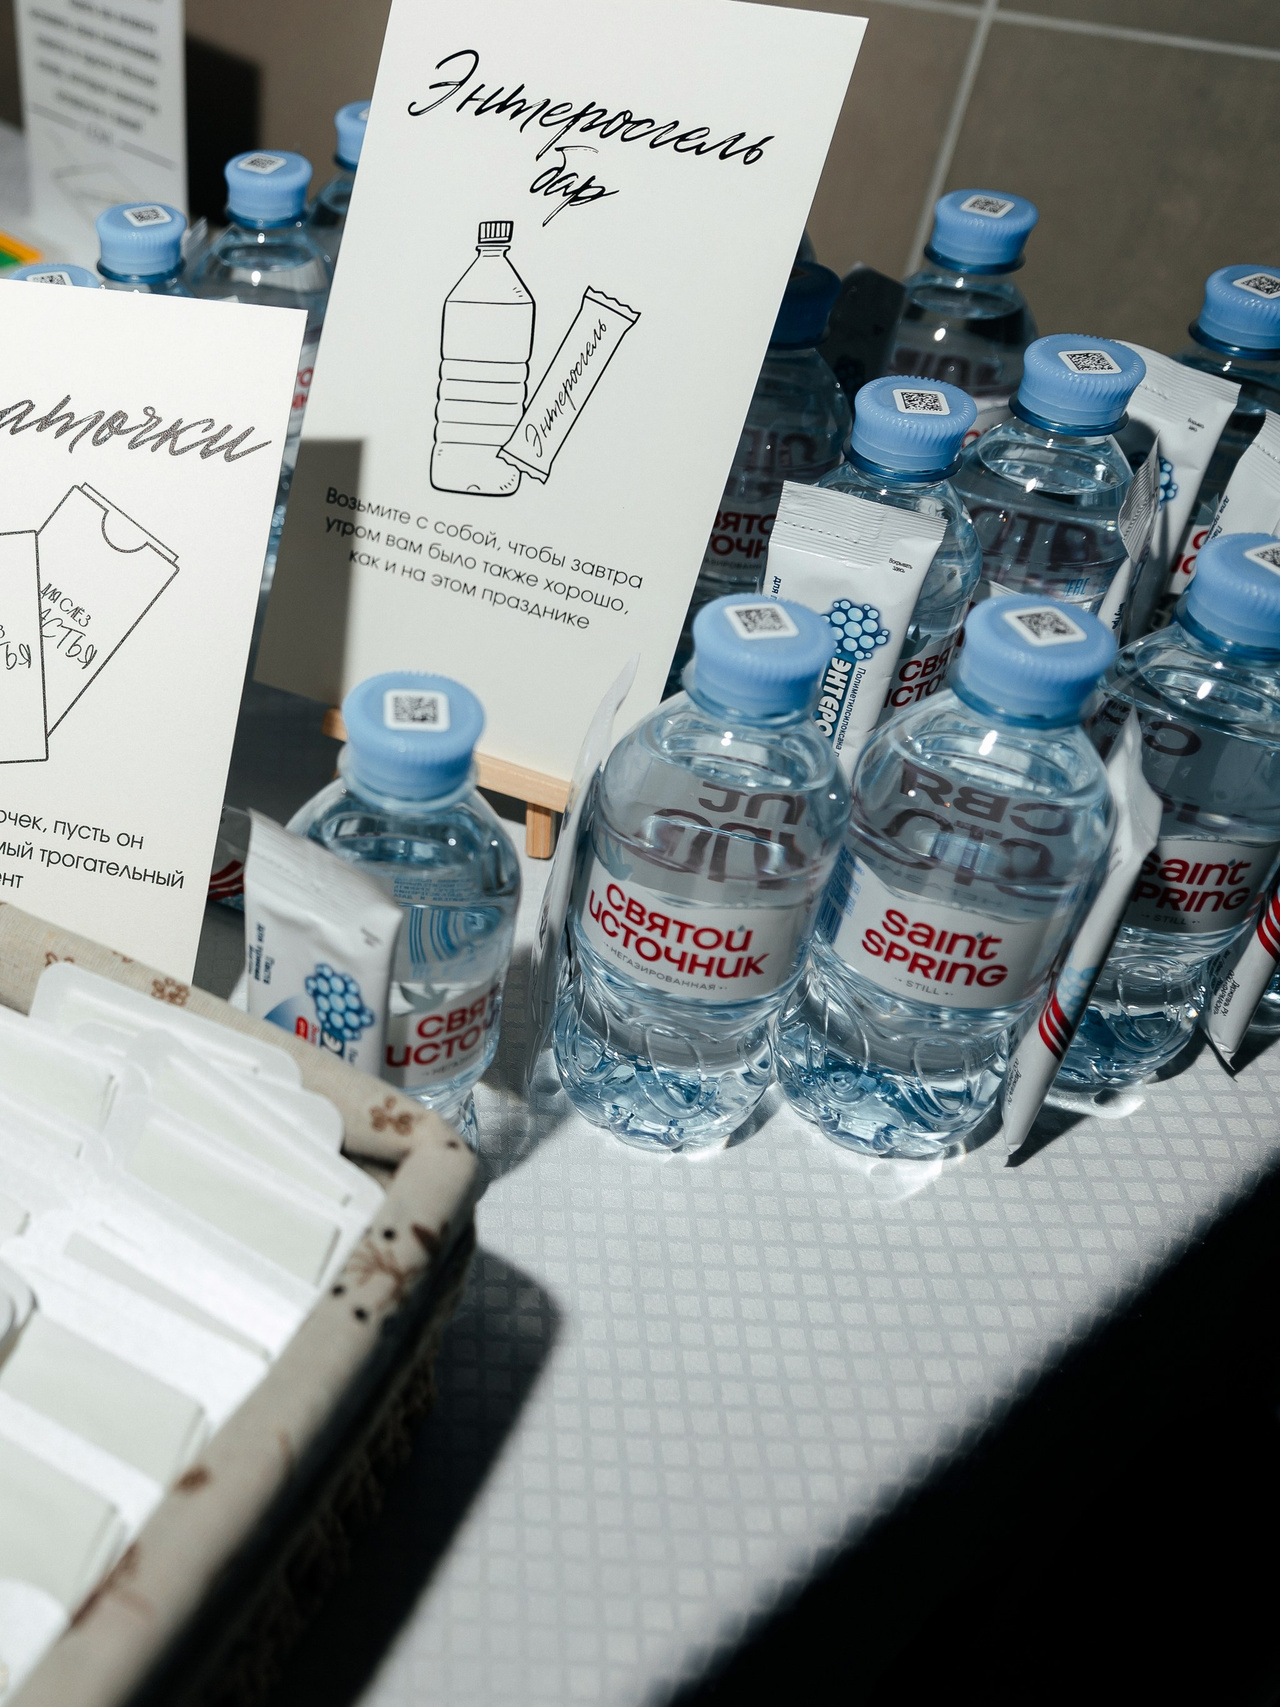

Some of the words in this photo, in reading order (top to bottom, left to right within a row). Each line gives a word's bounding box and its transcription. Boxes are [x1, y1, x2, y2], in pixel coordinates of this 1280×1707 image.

[529, 145, 619, 227] бар
[325, 516, 381, 544] утром
[385, 534, 423, 555] вам
[428, 543, 477, 569] было
[482, 560, 539, 587] также
[543, 578, 630, 615] хорошо,
[326, 487, 411, 524] Возьмите
[416, 516, 429, 530] с
[434, 524, 502, 551] собой,
[508, 541, 566, 568] чтобы
[571, 559, 644, 589] завтра
[348, 549, 379, 569] как
[385, 562, 397, 574] и
[401, 566, 426, 582] на
[431, 574, 477, 597] этом
[481, 587, 590, 630] празднике
[53, 819, 111, 844] пусть
[116, 833, 144, 850] он
[39, 847, 185, 889] трогательный
[1133, 882, 1250, 913] PRING
[588, 889, 769, 979] ИСТОЧНИК
[607, 883, 754, 952] СВЯТОЙ
[882, 909, 1003, 961] Saint
[610, 946, 717, 991] НЕГАЗИРОВАННАЯ
[862, 928, 1008, 988] SPRING
[906, 980, 940, 996] STILL
